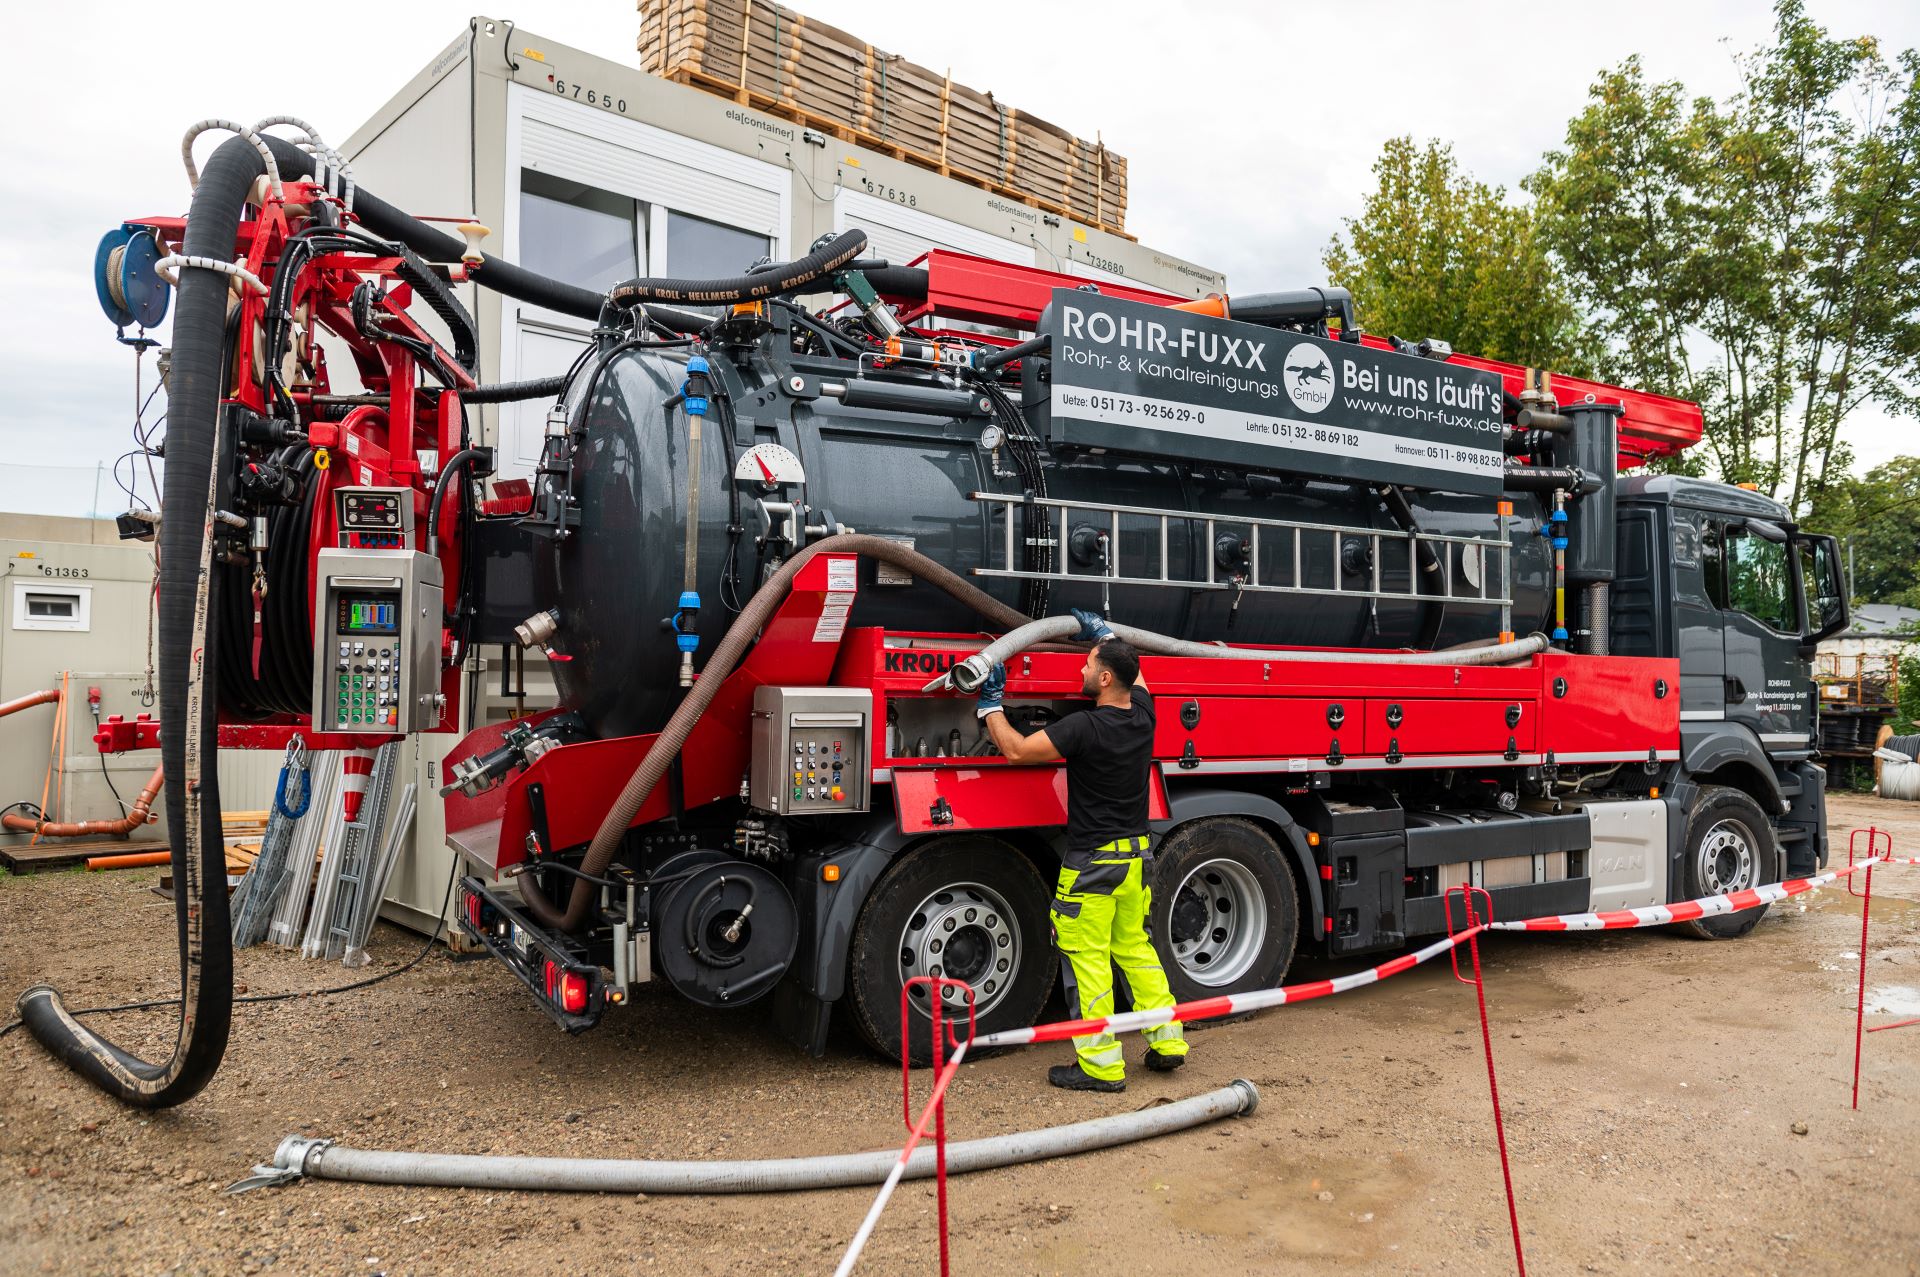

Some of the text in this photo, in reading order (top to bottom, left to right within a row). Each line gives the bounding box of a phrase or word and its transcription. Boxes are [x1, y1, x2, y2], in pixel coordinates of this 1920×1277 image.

[556, 80, 627, 113] 67650
[726, 109, 794, 142] ela[container]
[867, 180, 917, 207] 67638
[987, 199, 1037, 224] ela[container]
[655, 287, 680, 300] KROLL
[688, 289, 740, 301] HELLMERS
[751, 285, 771, 297] OIL
[781, 270, 816, 289] KROLL
[824, 246, 857, 273] HELLMERS
[1090, 255, 1124, 275] 732680
[1178, 265, 1215, 285] ela[container]
[1063, 305, 1267, 372] ROHR-FUXX
[1063, 345, 1279, 399] Rohr- & Kanalreinigungs
[1343, 359, 1379, 393] Bei
[1388, 374, 1428, 402] uns
[1063, 394, 1088, 408] Uetze:
[1293, 387, 1327, 404] GmbH
[1246, 421, 1270, 434] Lehrte:
[1344, 396, 1502, 433] www.rohr-fuxx.de
[1395, 444, 1426, 457] Hannover:
[44, 566, 89, 578] 61363
[189, 724, 197, 763] HELLMERS
[1599, 855, 1643, 873] MAN
